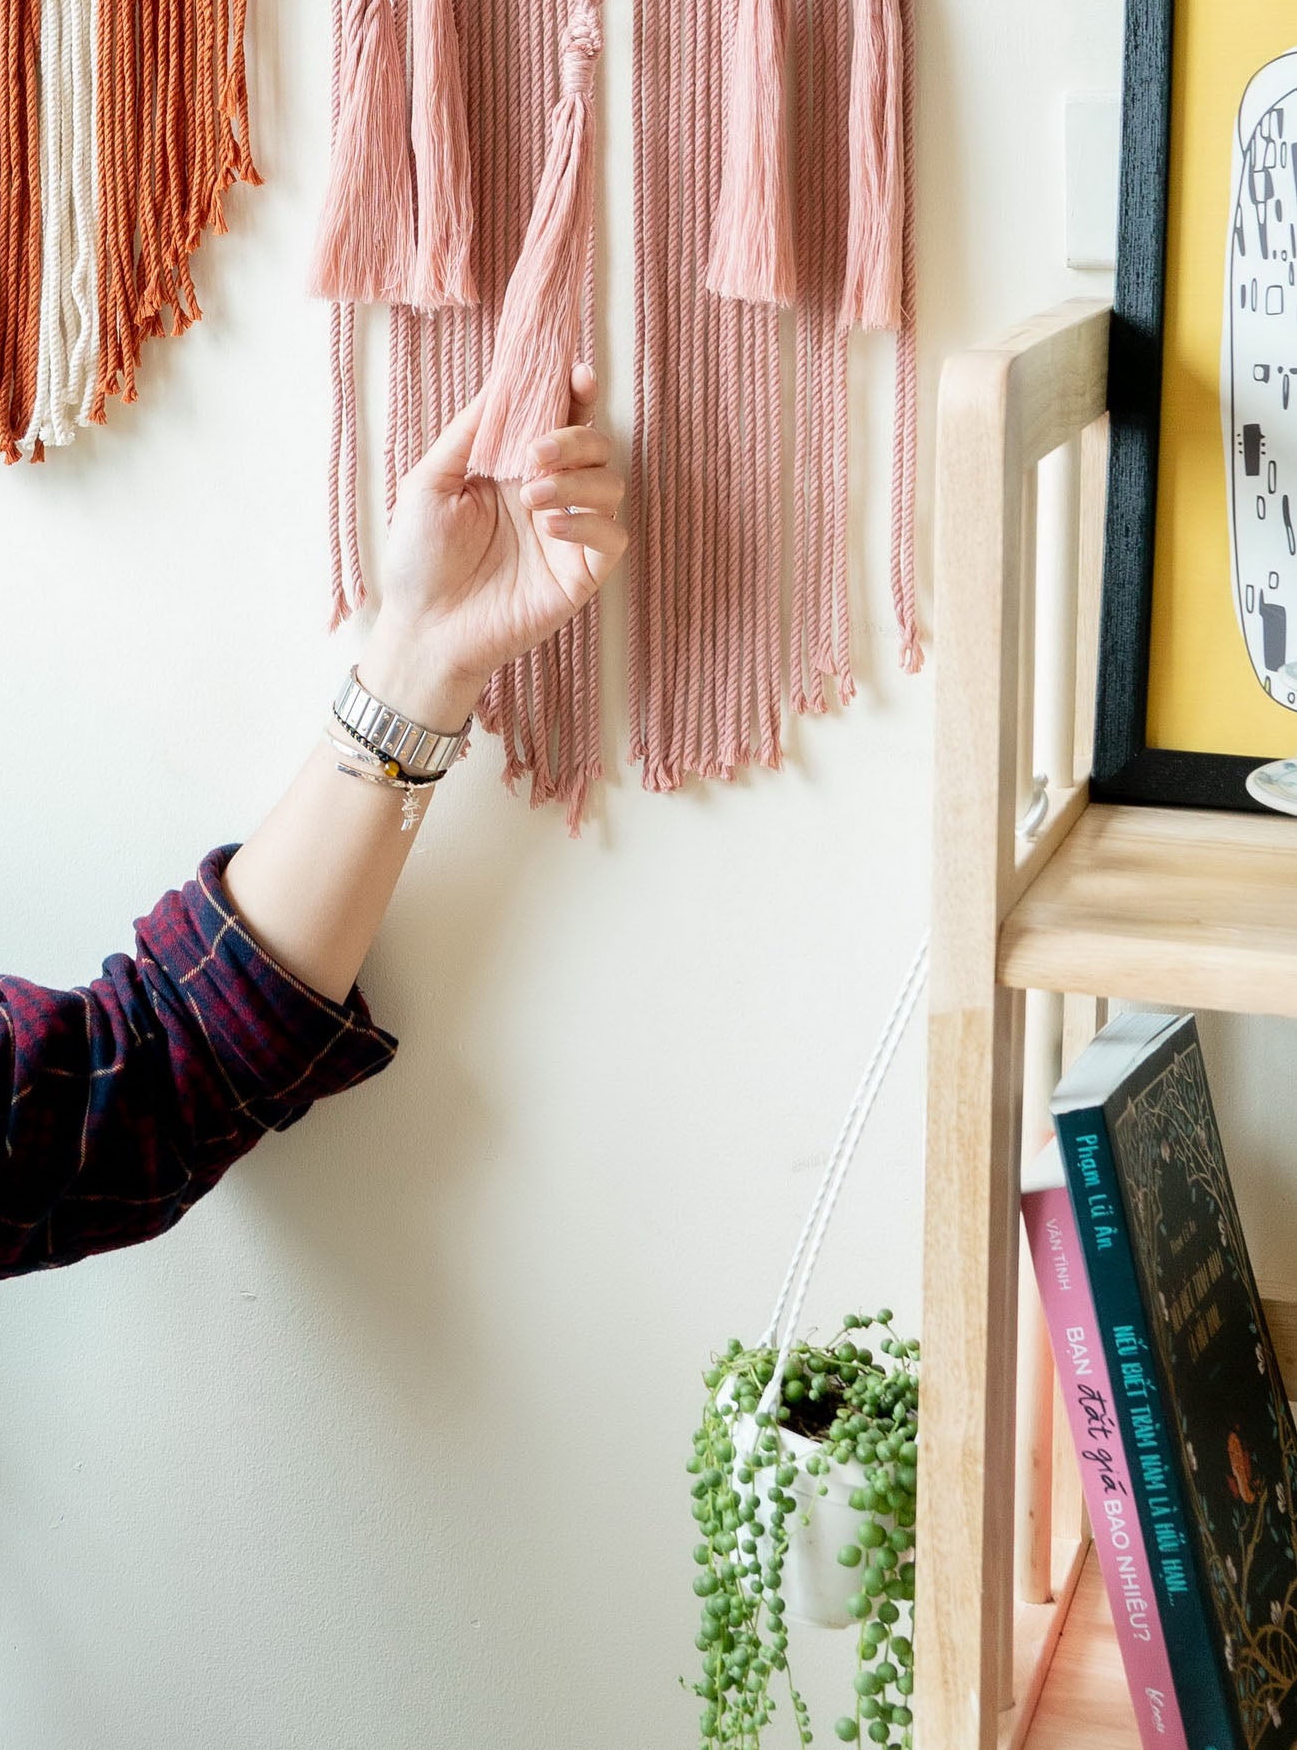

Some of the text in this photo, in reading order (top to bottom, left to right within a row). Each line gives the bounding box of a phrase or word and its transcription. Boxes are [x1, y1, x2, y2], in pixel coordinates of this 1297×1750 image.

[1076, 1134, 1101, 1189] Phạm
[1066, 1326, 1093, 1376] BẠN
[1113, 1325, 1149, 1357] NẾU
[1121, 1362, 1157, 1398] BIẾT
[1082, 1448, 1128, 1496] giá
[1104, 1499, 1131, 1550] BAO
[1116, 1555, 1152, 1642] NHIÊU?
